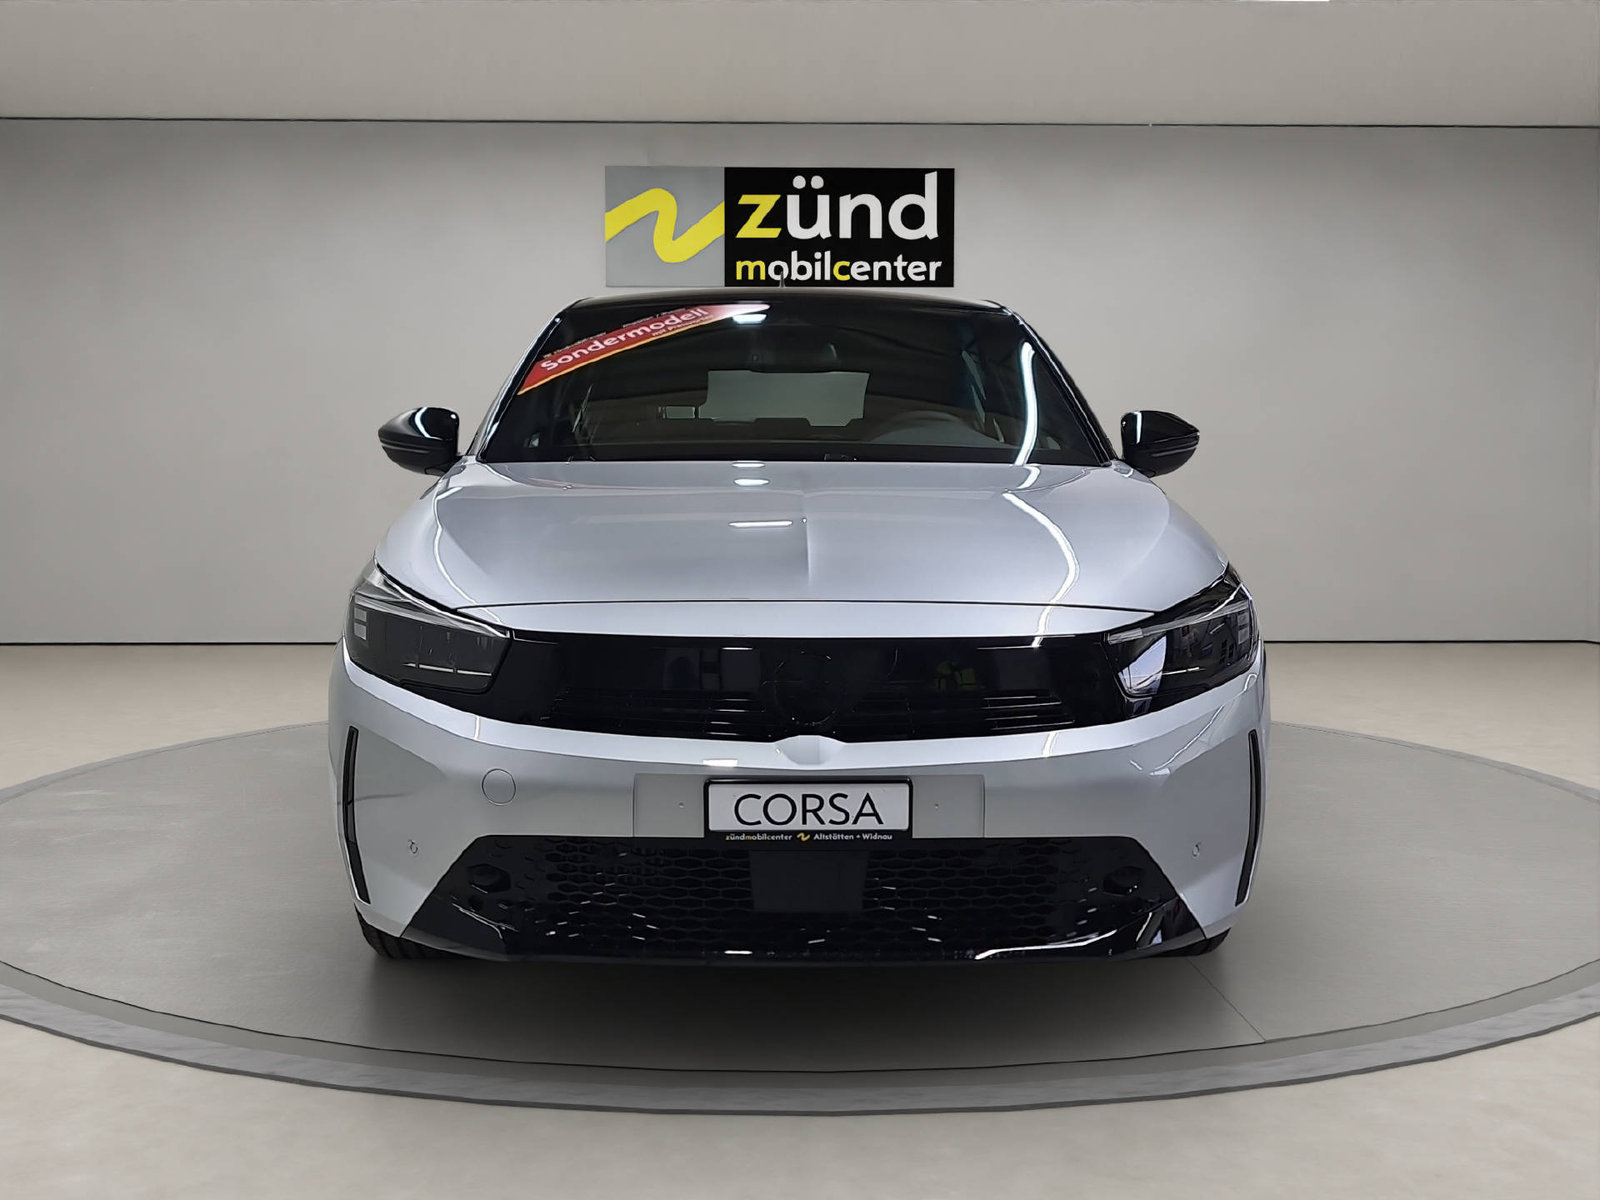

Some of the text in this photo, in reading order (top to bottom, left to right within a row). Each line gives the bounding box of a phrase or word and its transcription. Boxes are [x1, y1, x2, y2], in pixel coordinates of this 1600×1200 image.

[735, 171, 938, 240] zünd
[735, 250, 943, 281] mobilcenter
[540, 307, 710, 371] Sondermodell
[734, 792, 884, 826] CORSA
[725, 832, 893, 841] zündmobilcenter Altstätten Widnau
